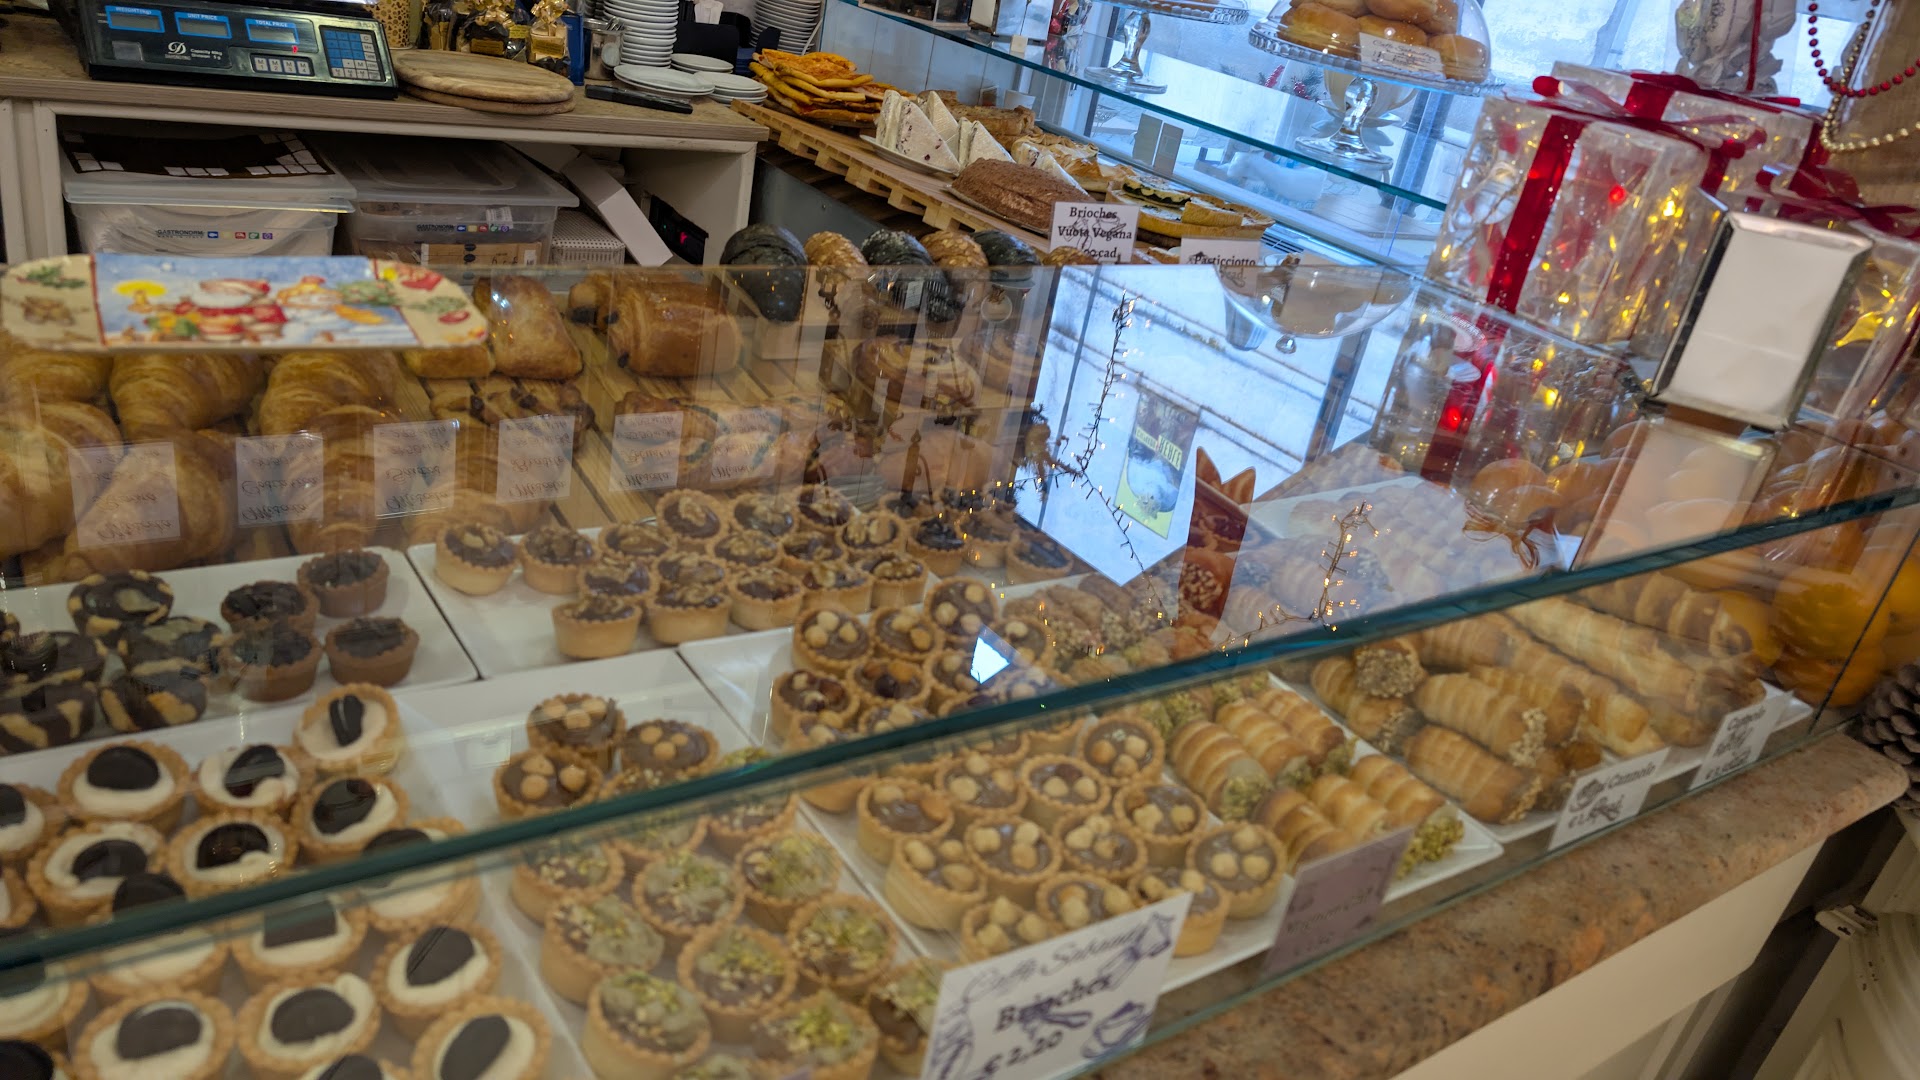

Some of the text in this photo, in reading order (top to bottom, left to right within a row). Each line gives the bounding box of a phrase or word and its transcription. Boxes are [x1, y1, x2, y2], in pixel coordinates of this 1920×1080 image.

[1069, 206, 1118, 219] Brioches
[1092, 227, 1133, 241] Vegana
[1193, 254, 1257, 267] Pasticciotto
